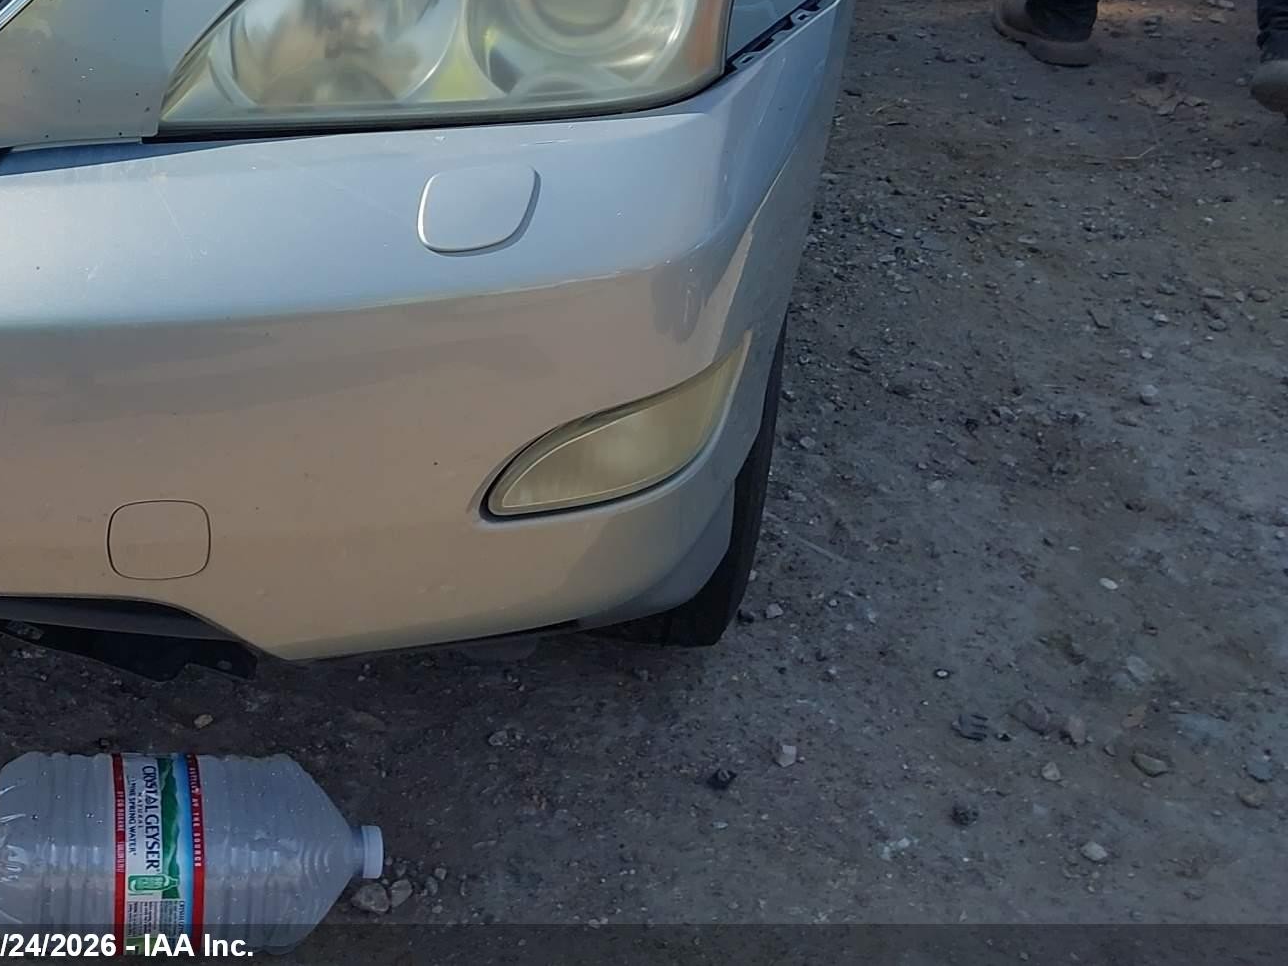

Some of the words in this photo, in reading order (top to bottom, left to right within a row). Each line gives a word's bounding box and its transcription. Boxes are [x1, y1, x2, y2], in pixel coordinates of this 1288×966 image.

[142, 765, 159, 813] CRYSTAL
[128, 797, 137, 825] SPRING
[128, 825, 137, 853] WATER
[144, 814, 161, 870] GEYSER
